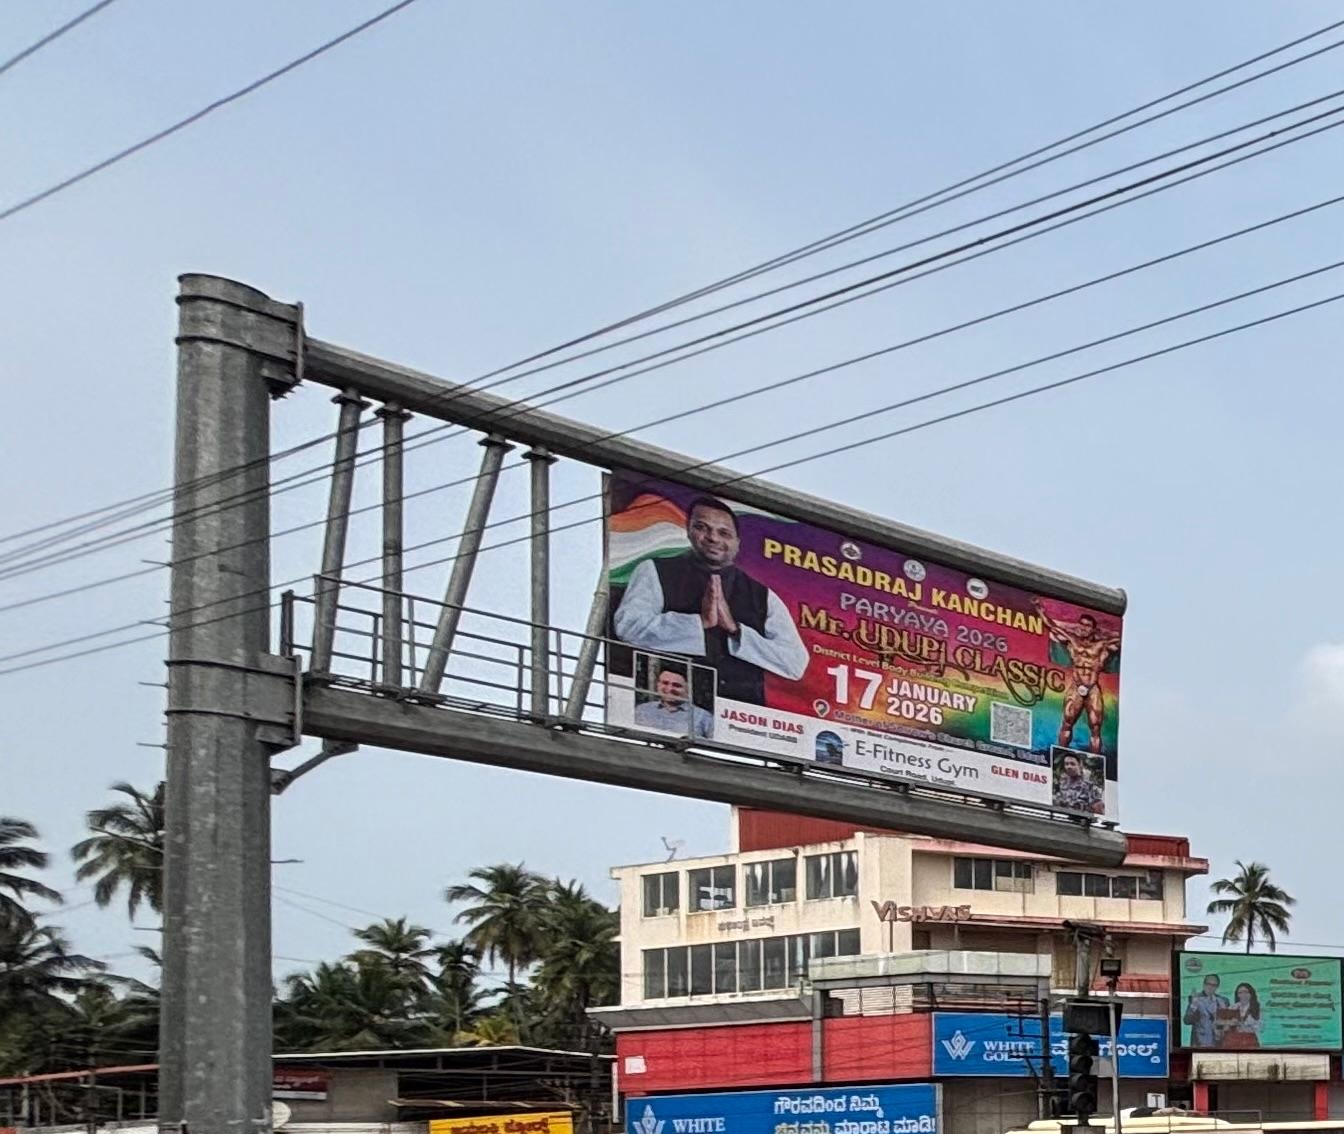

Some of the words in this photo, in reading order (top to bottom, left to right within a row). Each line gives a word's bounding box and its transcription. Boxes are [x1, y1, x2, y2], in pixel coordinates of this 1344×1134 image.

[764, 538, 922, 600] PRASADRAJ
[931, 588, 1044, 635] KANCHAN
[841, 593, 948, 637] PARYAYA
[957, 626, 1008, 652] 2026
[801, 604, 850, 639] Mr.
[853, 620, 948, 677] UDUPI
[955, 646, 1065, 698] CLASSIC
[853, 655, 879, 668] Level
[827, 664, 883, 710] 17
[886, 679, 976, 713] JANUARY
[721, 708, 768, 728] JASON
[773, 719, 804, 735] DIAS
[886, 696, 943, 726] 2026
[855, 740, 932, 770] E-Fitness
[938, 757, 979, 780] Gym
[991, 765, 1019, 778] GLEN
[1022, 771, 1048, 785] DIAS
[983, 1040, 1036, 1052] WHITE
[672, 1117, 726, 1134] WHITE
